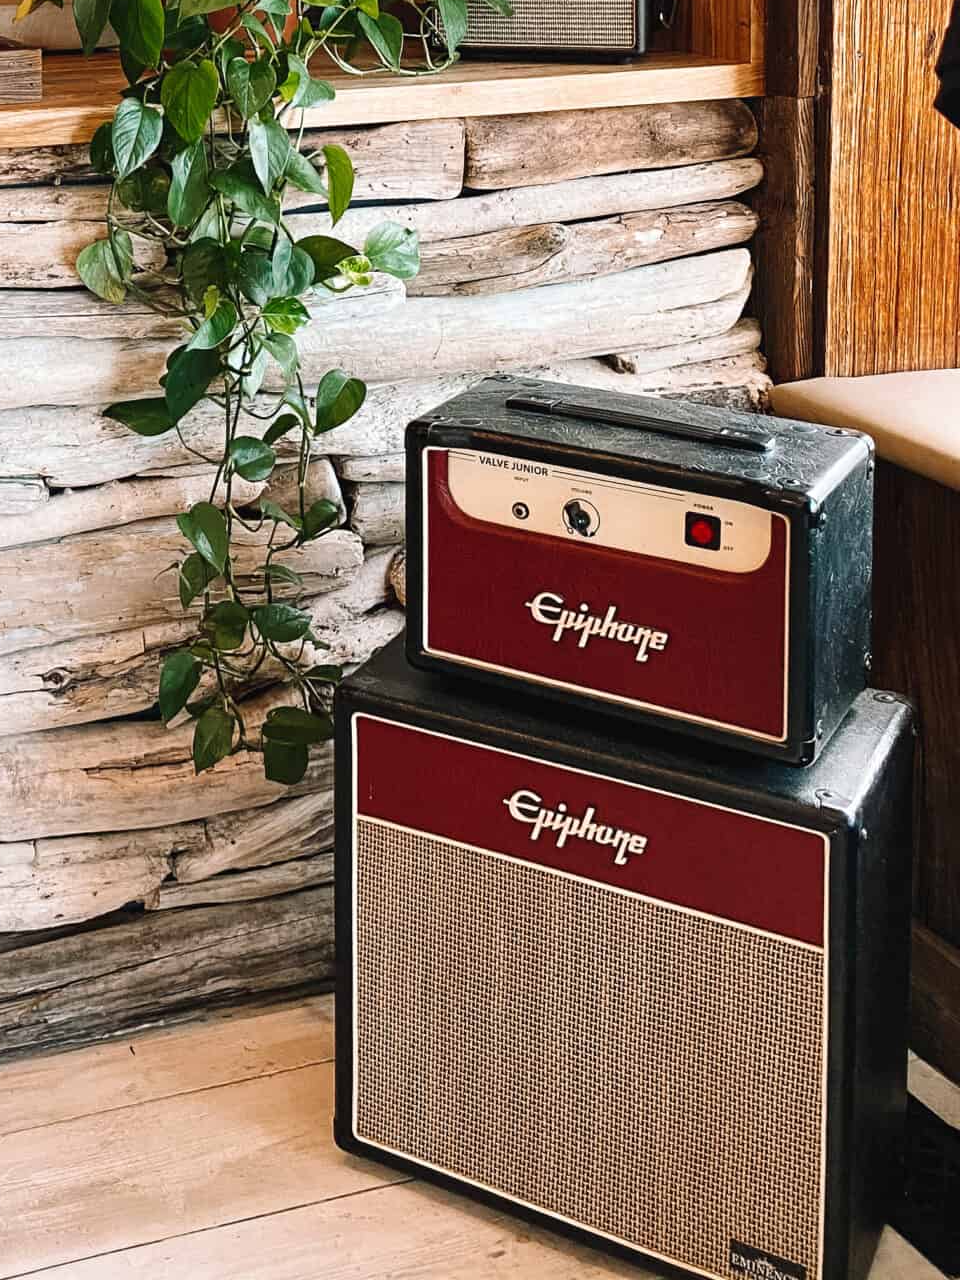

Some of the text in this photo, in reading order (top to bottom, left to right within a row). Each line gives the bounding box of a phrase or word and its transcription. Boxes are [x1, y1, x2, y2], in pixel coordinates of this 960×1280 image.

[478, 455, 549, 477] VALVE JUNIOR
[524, 592, 669, 662] Epiphone
[502, 789, 649, 865] Epiphone
